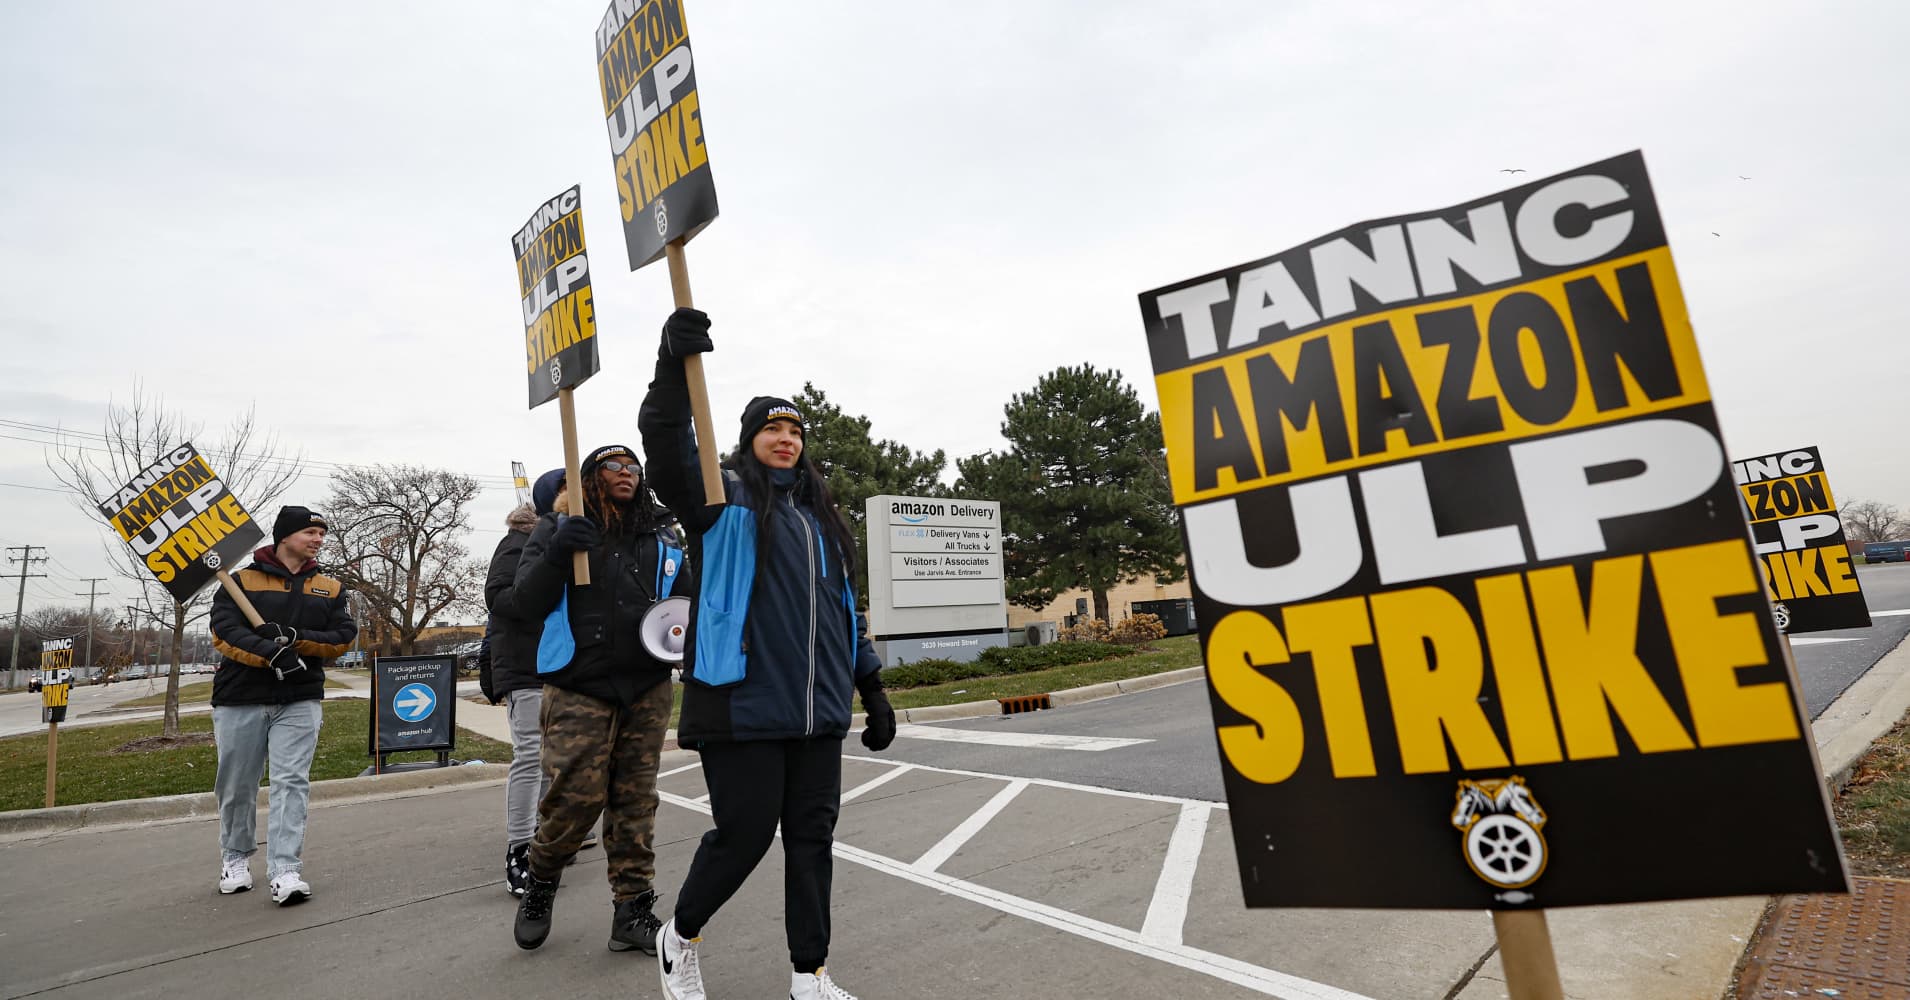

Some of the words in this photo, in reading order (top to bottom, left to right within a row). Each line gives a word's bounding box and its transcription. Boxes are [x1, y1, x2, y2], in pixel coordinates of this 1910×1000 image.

[598, 0, 643, 55] TAN
[603, 0, 684, 111] AMAZON
[608, 45, 692, 155] ULP
[616, 89, 707, 222] STRIKE
[514, 189, 577, 253] TANNC
[521, 213, 582, 292] AMAZON
[523, 254, 588, 326] ULP
[1156, 174, 1634, 360] TANNC
[527, 285, 596, 375] STRIKE
[1192, 260, 1683, 493] AMAZON
[103, 447, 192, 513] TANNC
[118, 459, 211, 537] AMAZON
[128, 479, 223, 555] ULP
[892, 502, 945, 516] amazon
[951, 505, 994, 519] Delivery
[1183, 419, 1723, 606] ULP
[1740, 474, 1829, 521] ZON
[147, 494, 250, 582] STRIKE
[904, 556, 938, 566] Visitors
[945, 557, 989, 566] Associates
[930, 529, 961, 539] Delivery
[962, 530, 980, 539] Vans
[945, 542, 955, 550] All
[957, 542, 981, 550] Trucks
[1750, 514, 1840, 555] LP
[388, 665, 417, 673] Package
[1207, 539, 1800, 784] STRIKE
